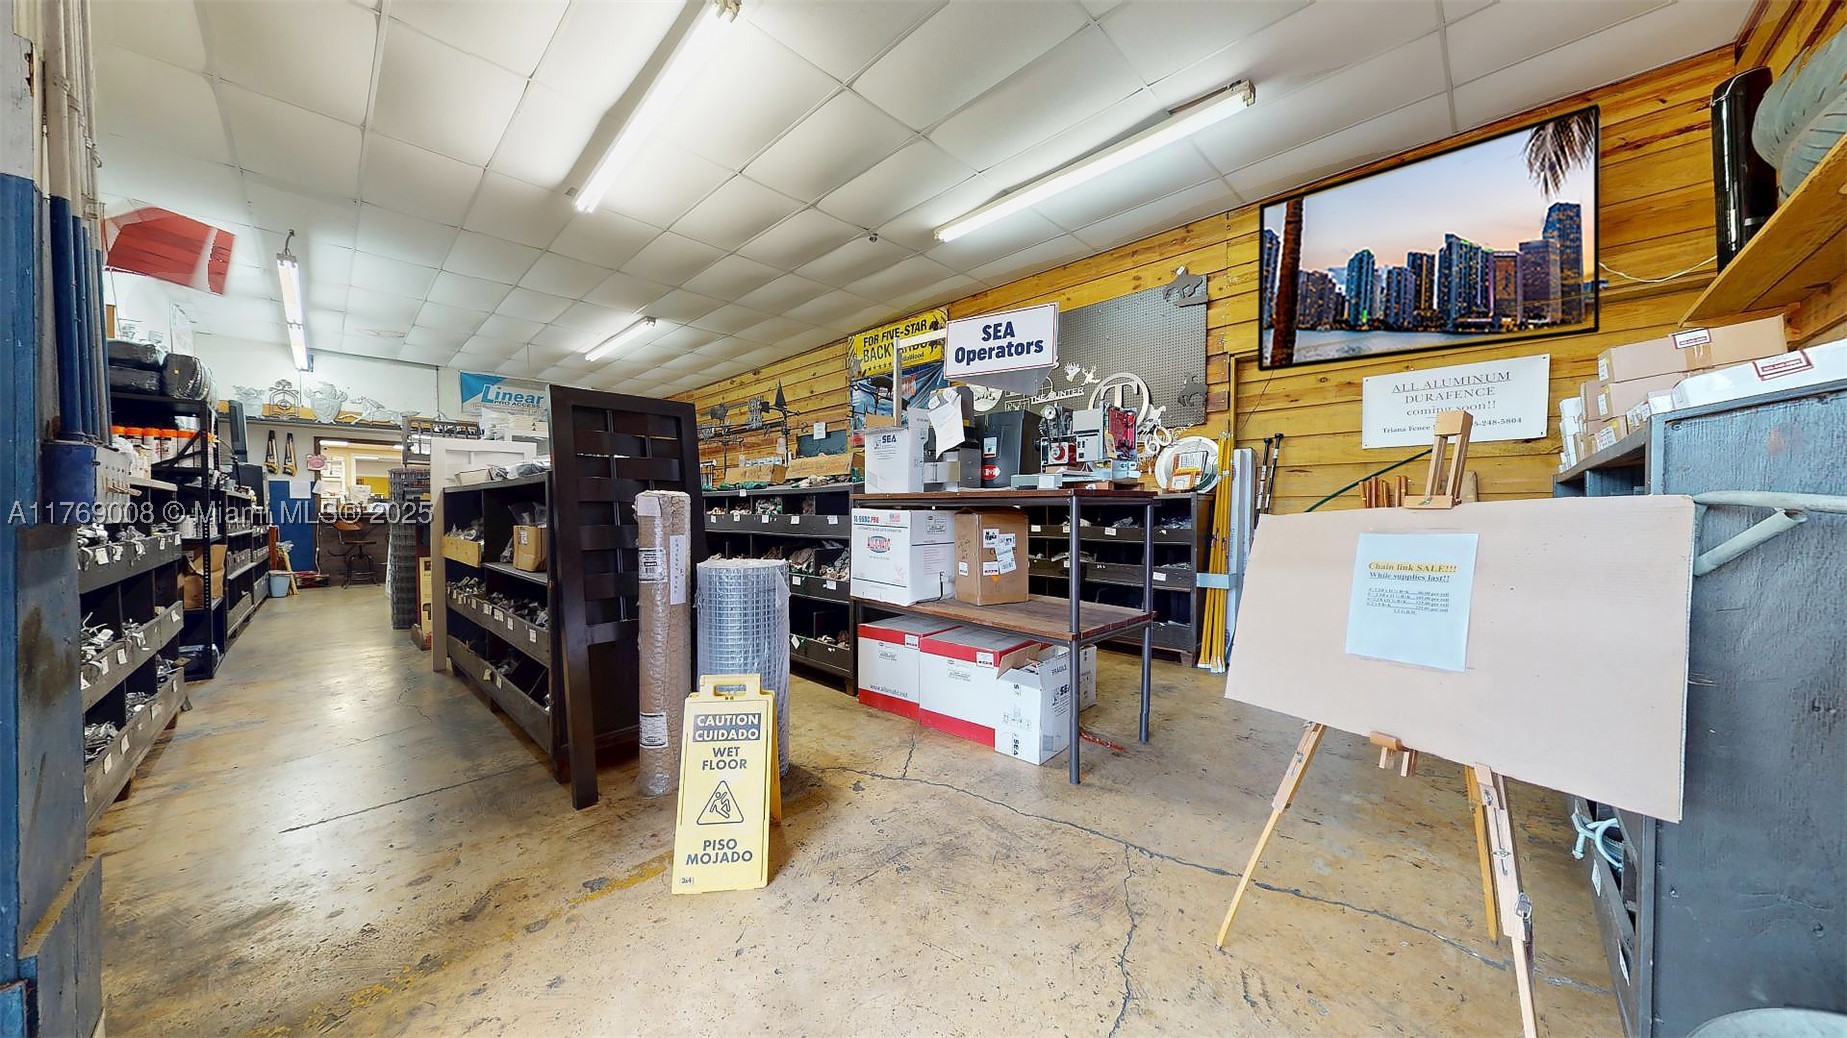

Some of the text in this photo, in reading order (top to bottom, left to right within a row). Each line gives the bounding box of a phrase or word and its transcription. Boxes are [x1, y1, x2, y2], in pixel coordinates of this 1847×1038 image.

[863, 319, 927, 348] FOR FIVE-STAR
[981, 321, 1016, 342] SEA
[954, 339, 1044, 366] Operators
[1392, 371, 1511, 394] ALL ALUMINUM
[481, 384, 544, 405] Linear
[1405, 386, 1495, 404] DURAFENCE
[881, 434, 897, 444] SEA
[1368, 561, 1394, 570] Chain
[1396, 563, 1414, 572] link
[1369, 571, 1391, 580] While
[1393, 573, 1425, 582] supplies
[697, 714, 759, 727] CAUTION
[695, 728, 759, 741] CUIDADO
[712, 746, 741, 758] WET
[702, 758, 748, 771] FLOOR
[702, 838, 738, 852] PISO
[685, 850, 753, 866] MOJADO
